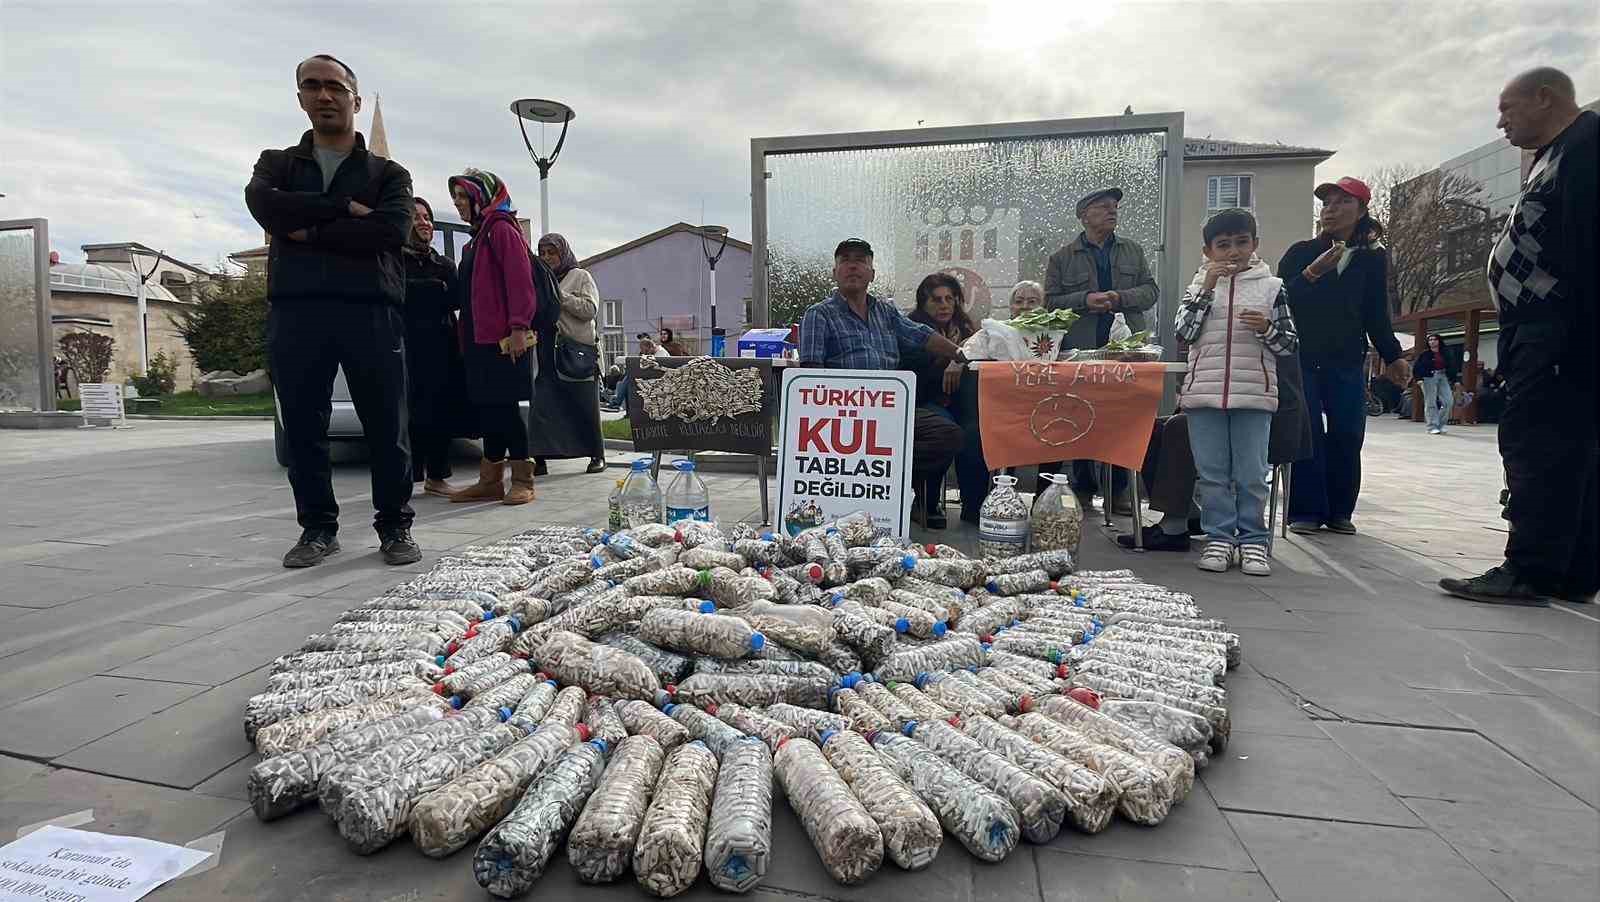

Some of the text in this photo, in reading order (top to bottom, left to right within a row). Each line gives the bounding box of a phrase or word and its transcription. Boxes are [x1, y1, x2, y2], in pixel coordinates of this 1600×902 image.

[799, 384, 896, 408] TÜRKİYE
[798, 410, 892, 456] KÜL
[795, 456, 892, 478] TABLASI
[61, 866, 87, 881] bir
